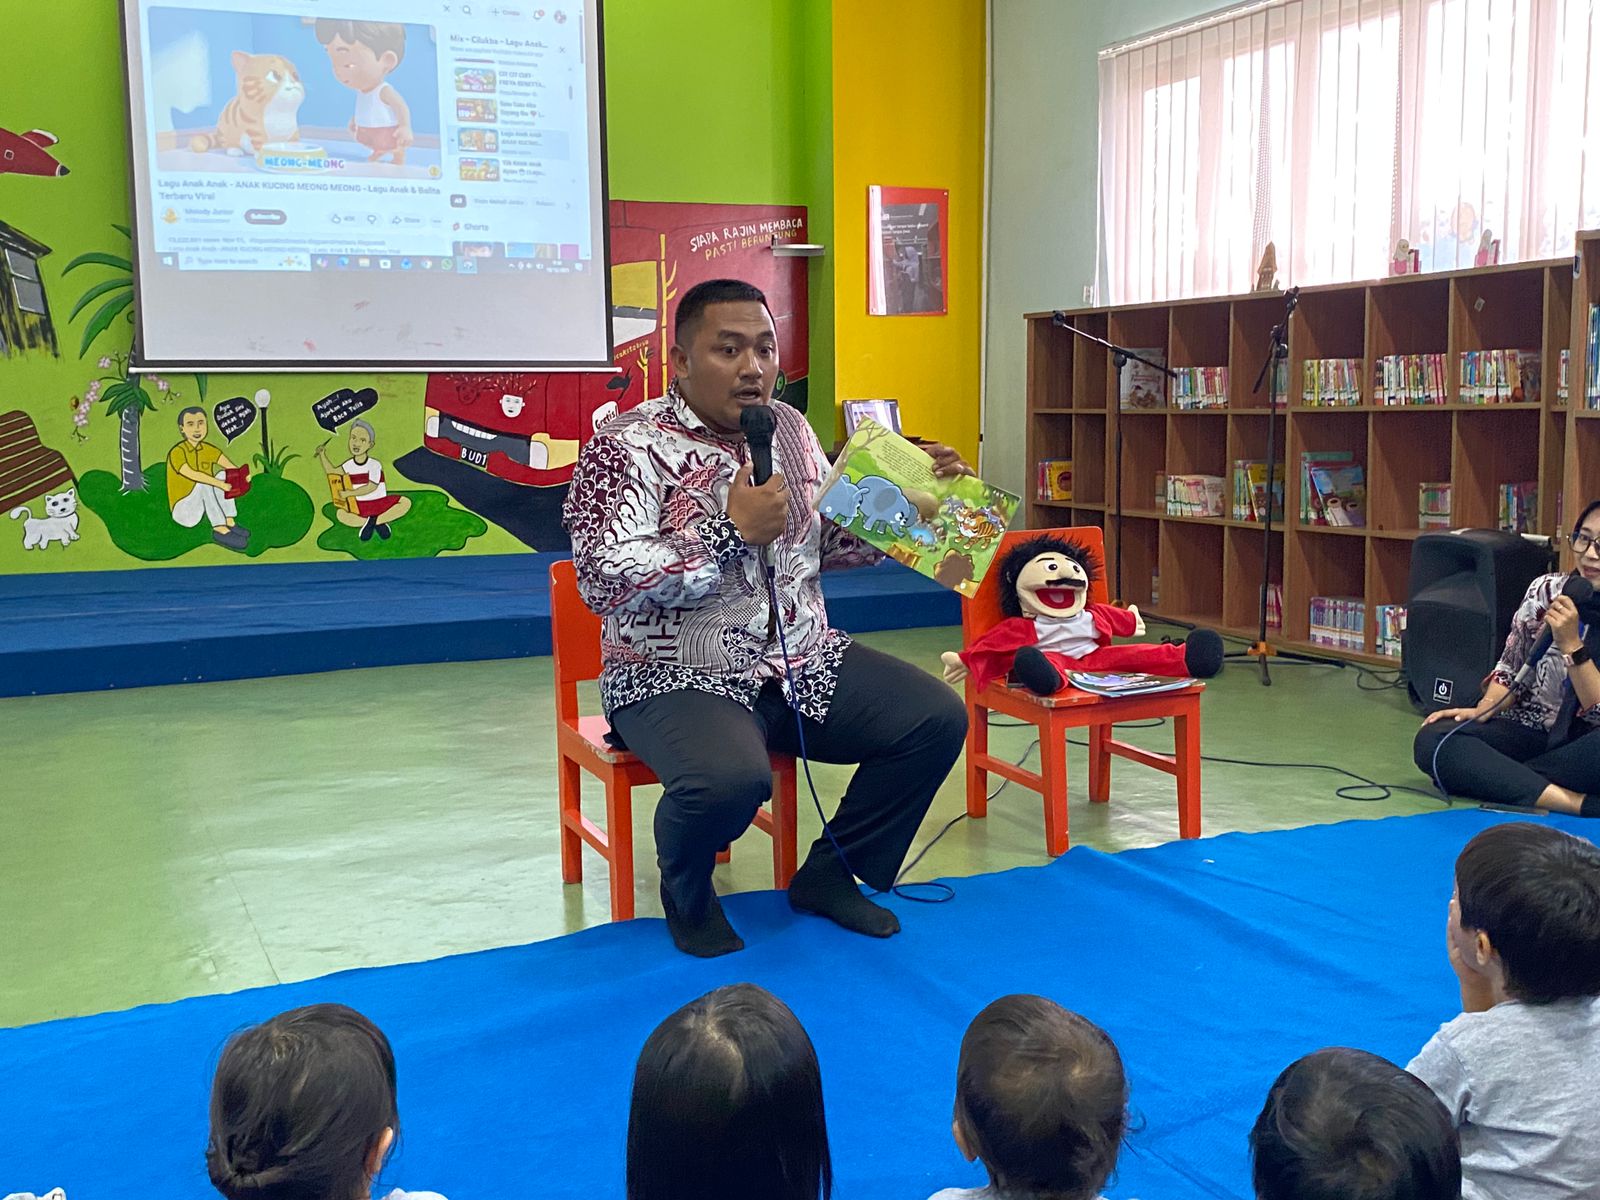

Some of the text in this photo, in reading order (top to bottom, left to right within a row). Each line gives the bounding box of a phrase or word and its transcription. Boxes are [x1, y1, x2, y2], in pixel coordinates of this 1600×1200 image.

[450, 34, 464, 43] Mix
[505, 37, 524, 48] Lagu
[264, 156, 345, 169] MEONG-MEONG
[158, 179, 180, 190] Lagu
[182, 179, 205, 188] Anak
[206, 179, 228, 189] Anak
[235, 180, 260, 190] ANAK
[262, 181, 295, 191] KUCING
[297, 182, 328, 192] MEONG
[330, 183, 361, 193] MEONG
[368, 184, 389, 195] Lagu
[389, 185, 409, 194] Anak
[159, 191, 216, 201] Terbaru Viral
[690, 218, 803, 253] SIAPA RAJIN MEMBACA
[705, 240, 738, 261] PASTI
